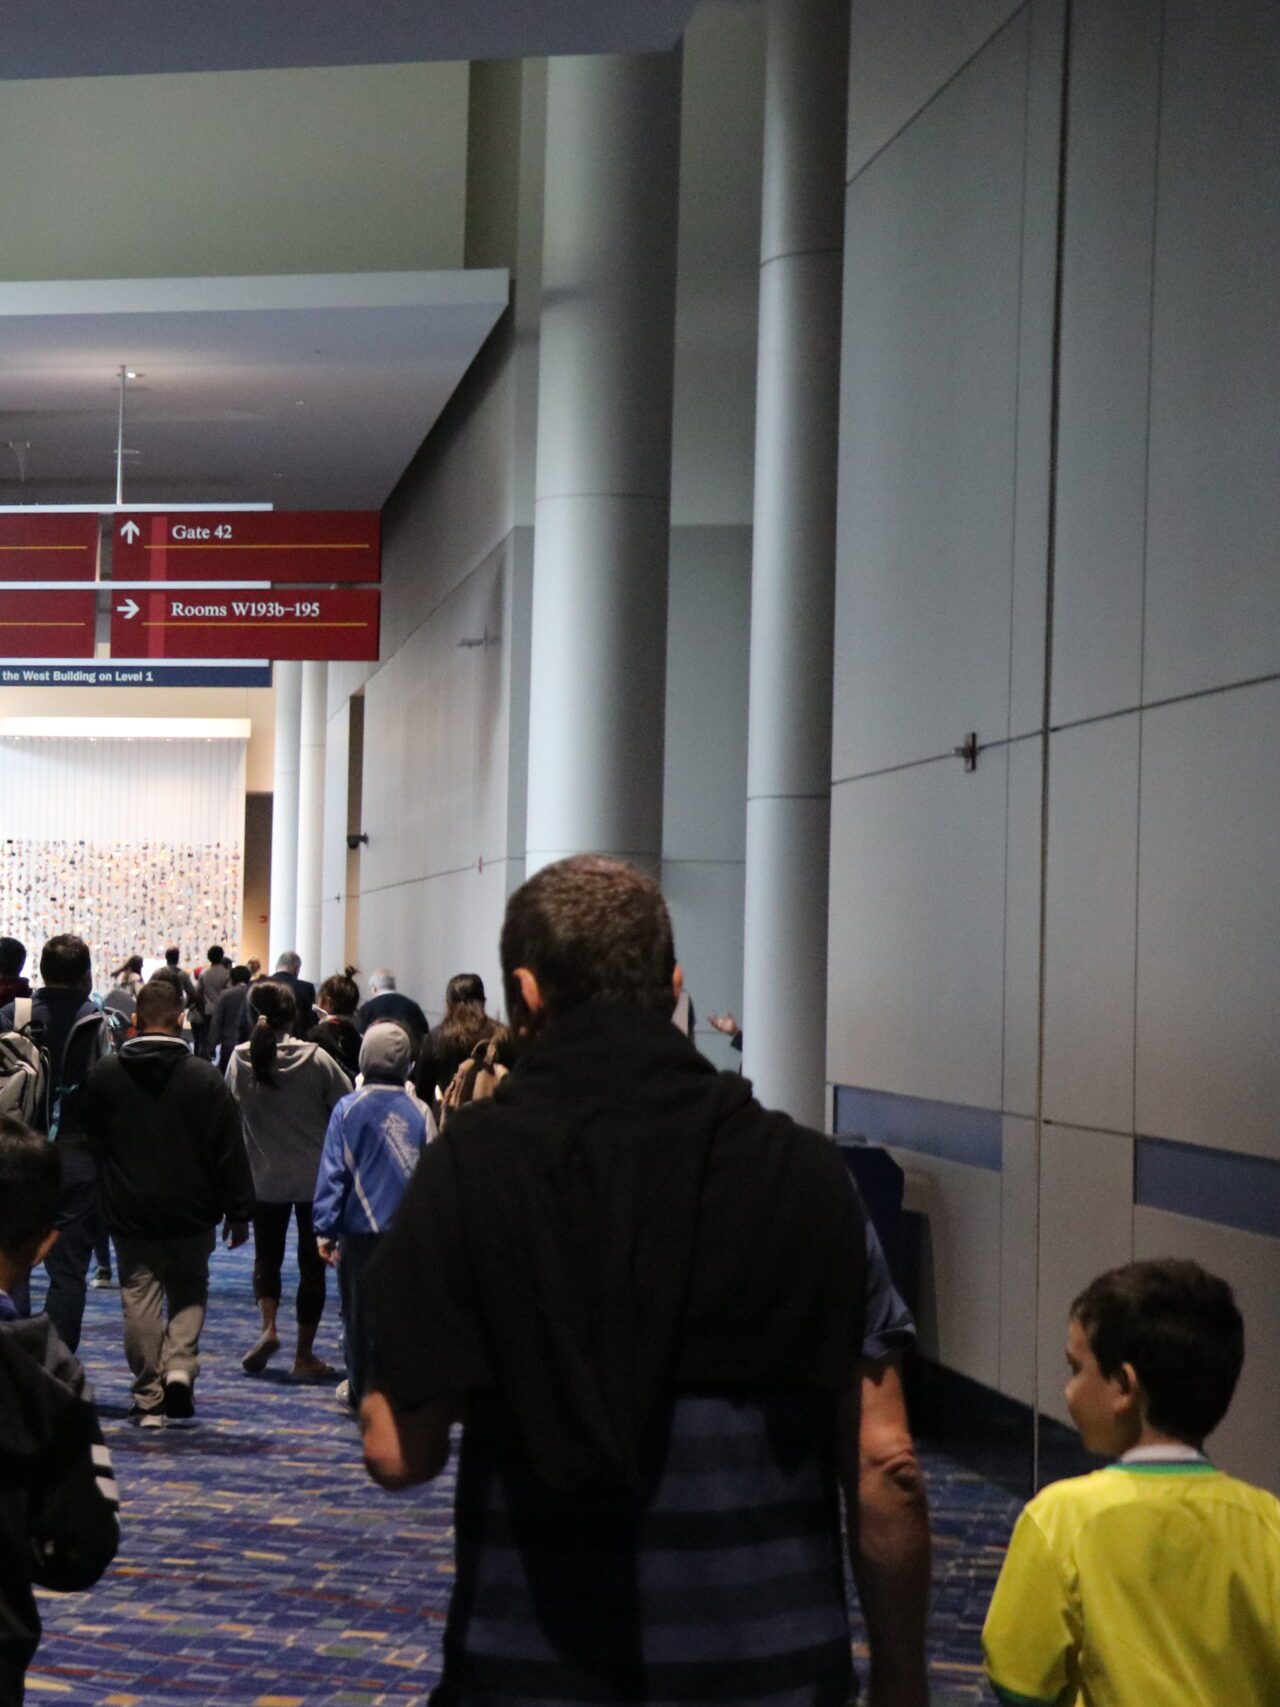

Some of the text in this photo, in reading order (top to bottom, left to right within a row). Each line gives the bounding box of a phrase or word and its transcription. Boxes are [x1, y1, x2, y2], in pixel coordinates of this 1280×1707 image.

[171, 524, 233, 539] Gate 42
[171, 602, 227, 616] Rooms
[2, 670, 20, 681] the
[22, 670, 50, 681] West
[53, 671, 97, 683] Building
[98, 671, 113, 681] on
[115, 671, 143, 681] Level
[145, 671, 154, 681] 1
